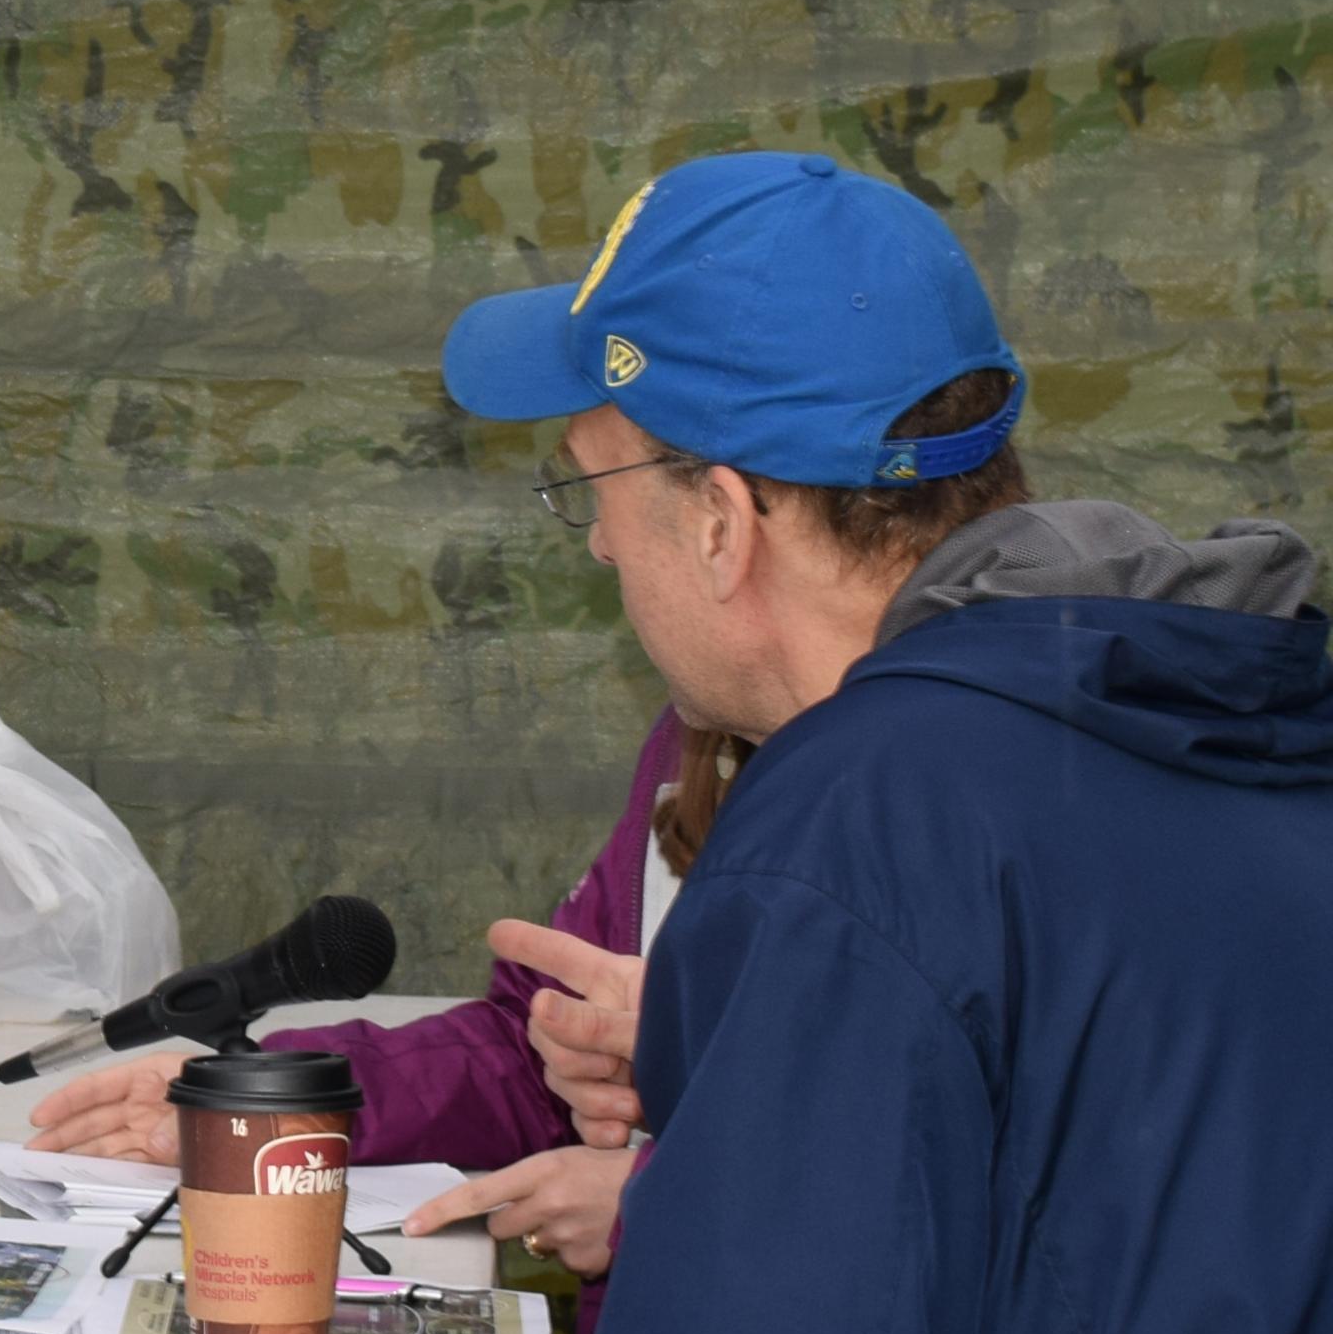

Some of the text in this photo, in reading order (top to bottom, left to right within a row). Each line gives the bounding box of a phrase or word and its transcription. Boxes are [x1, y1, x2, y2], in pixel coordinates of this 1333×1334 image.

[231, 1118, 248, 1137] 16
[267, 1165, 345, 1195] Wawa
[194, 1250, 269, 1269] Children's
[194, 1267, 316, 1285] Miracle Network
[195, 1286, 258, 1303] Hospitals
